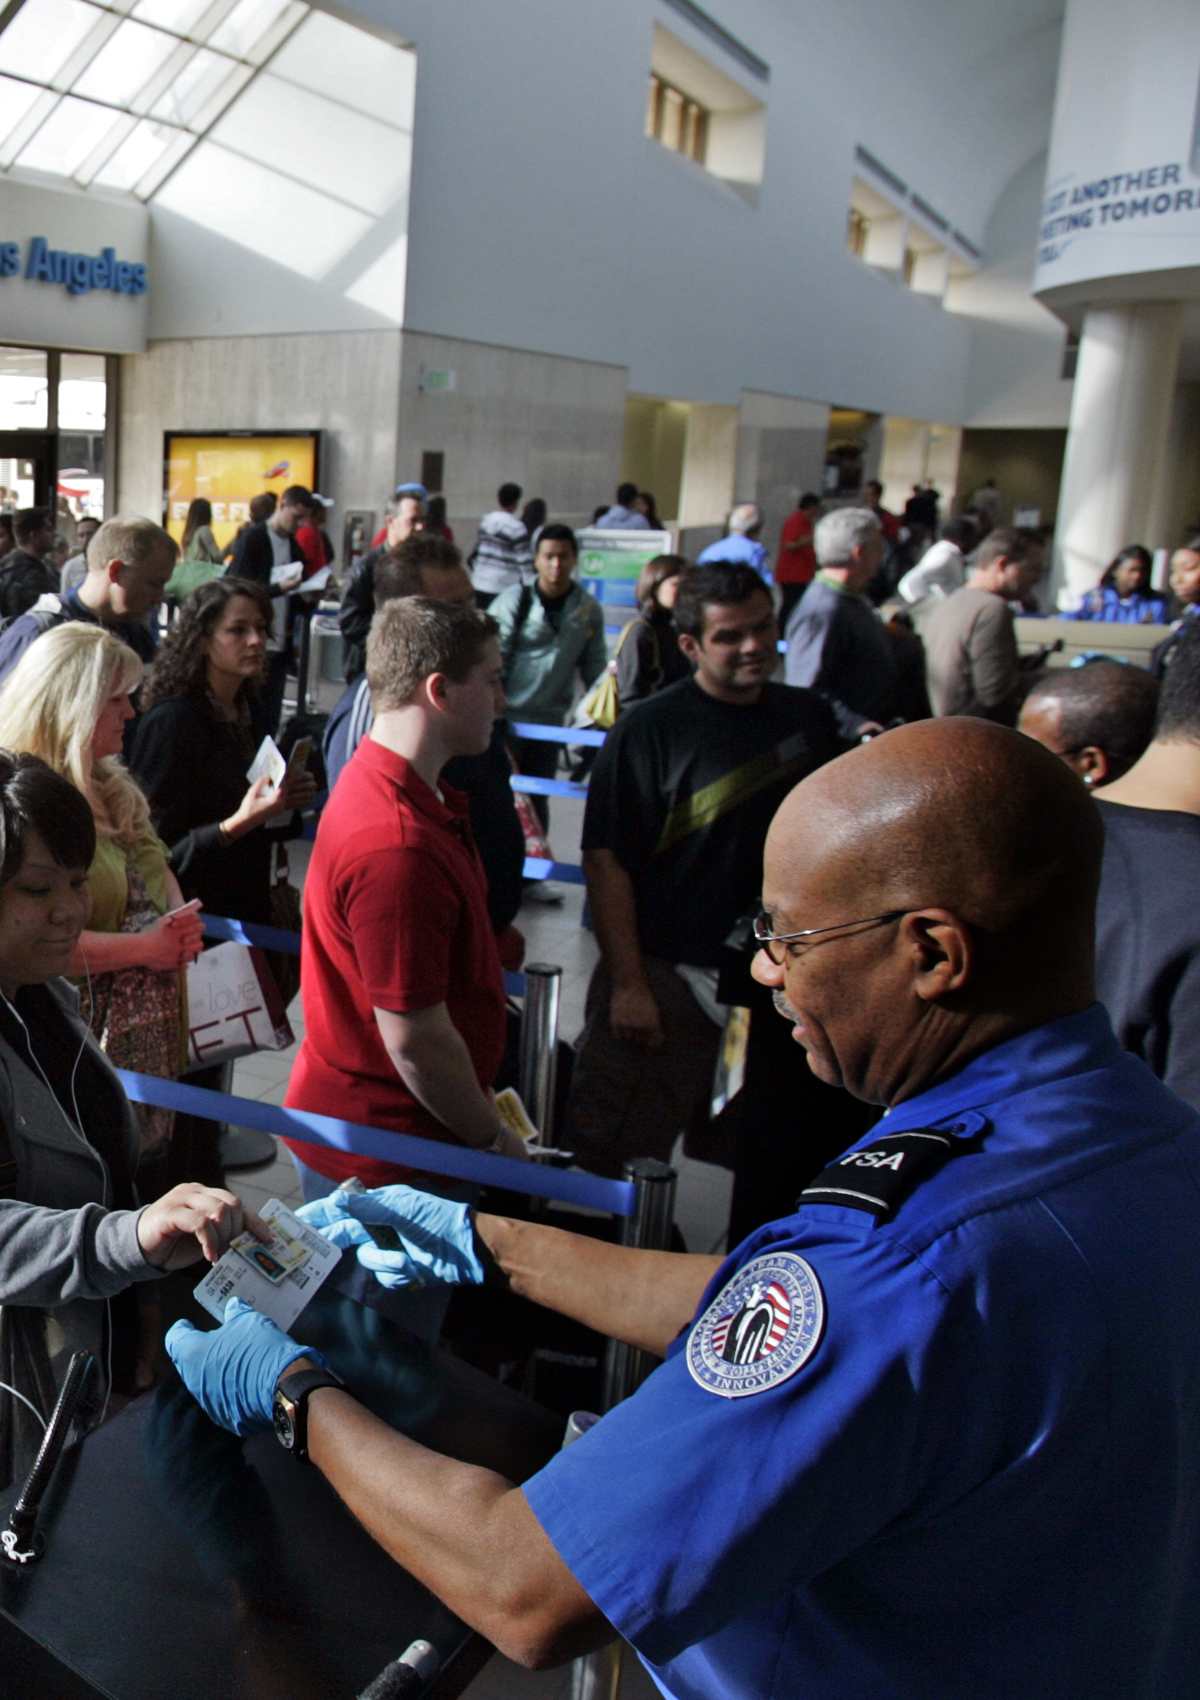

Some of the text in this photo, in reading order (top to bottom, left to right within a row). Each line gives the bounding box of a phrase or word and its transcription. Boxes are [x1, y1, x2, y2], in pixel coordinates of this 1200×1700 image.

[1069, 163, 1181, 205] ANOTHER
[1099, 189, 1200, 225] TOMOR
[26, 235, 148, 295] Angeles
[207, 980, 257, 1013] love
[840, 1151, 905, 1171] TSA
[748, 1257, 817, 1313] TEAM SPIRIT
[714, 1332, 812, 1390] INNOVATION
